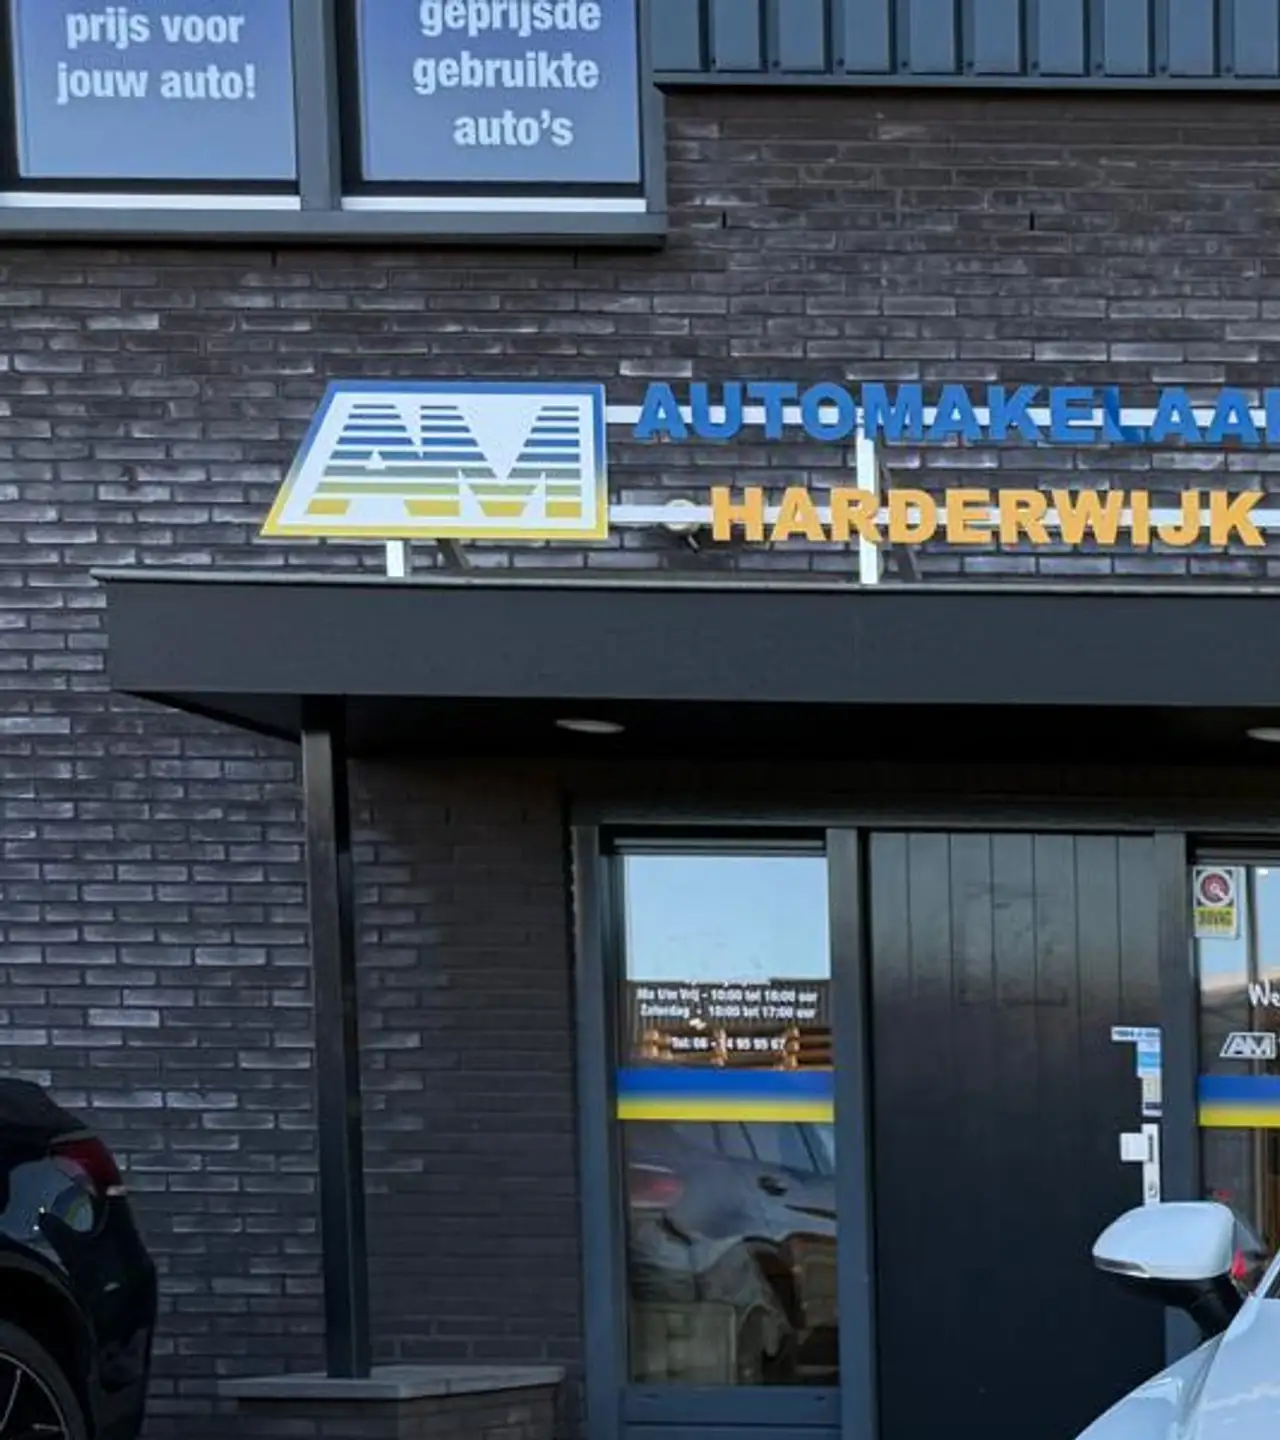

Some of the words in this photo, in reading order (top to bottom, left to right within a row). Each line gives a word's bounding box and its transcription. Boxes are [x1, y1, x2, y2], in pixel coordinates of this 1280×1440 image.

[66, 9, 150, 50] prijs
[161, 13, 244, 43] voor
[420, 0, 602, 37] geprijsde
[57, 63, 148, 104] jouw
[160, 63, 257, 100] auto!
[413, 52, 600, 95] gebruikte
[453, 110, 574, 147] auto's
[709, 485, 1266, 548] HARDERWIJK
